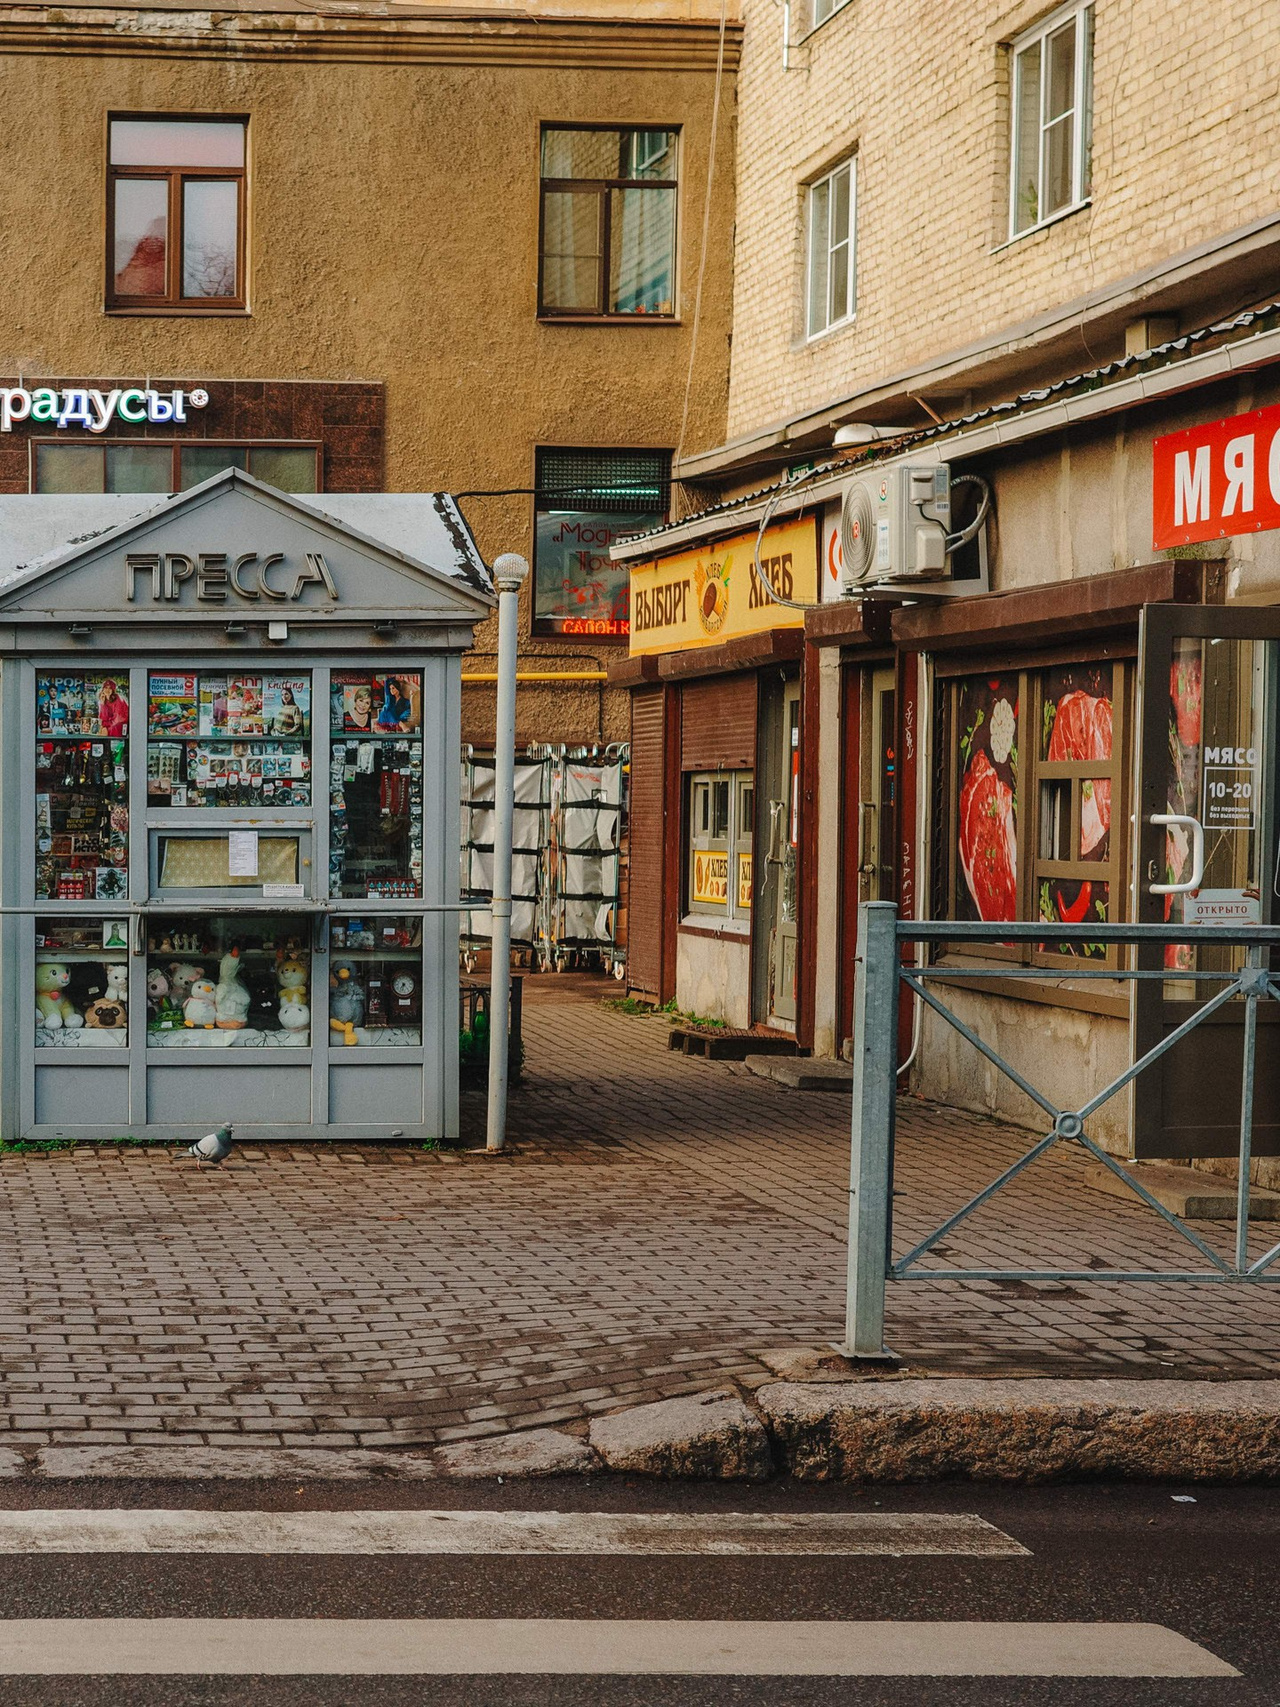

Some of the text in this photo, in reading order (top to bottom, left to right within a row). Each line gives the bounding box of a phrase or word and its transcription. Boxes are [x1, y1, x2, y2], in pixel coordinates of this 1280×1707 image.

[575, 551, 625, 571] Точк
[125, 553, 339, 601] ПРЕССА
[635, 553, 793, 633] ВЫБОРГ ХЛЕБ
[1204, 746, 1258, 765] МЯСО
[1209, 782, 1252, 798] 10-20
[74, 837, 99, 845] РУСС
[742, 861, 751, 881] ХЛ
[1197, 905, 1248, 914] ОТКРЫТО
